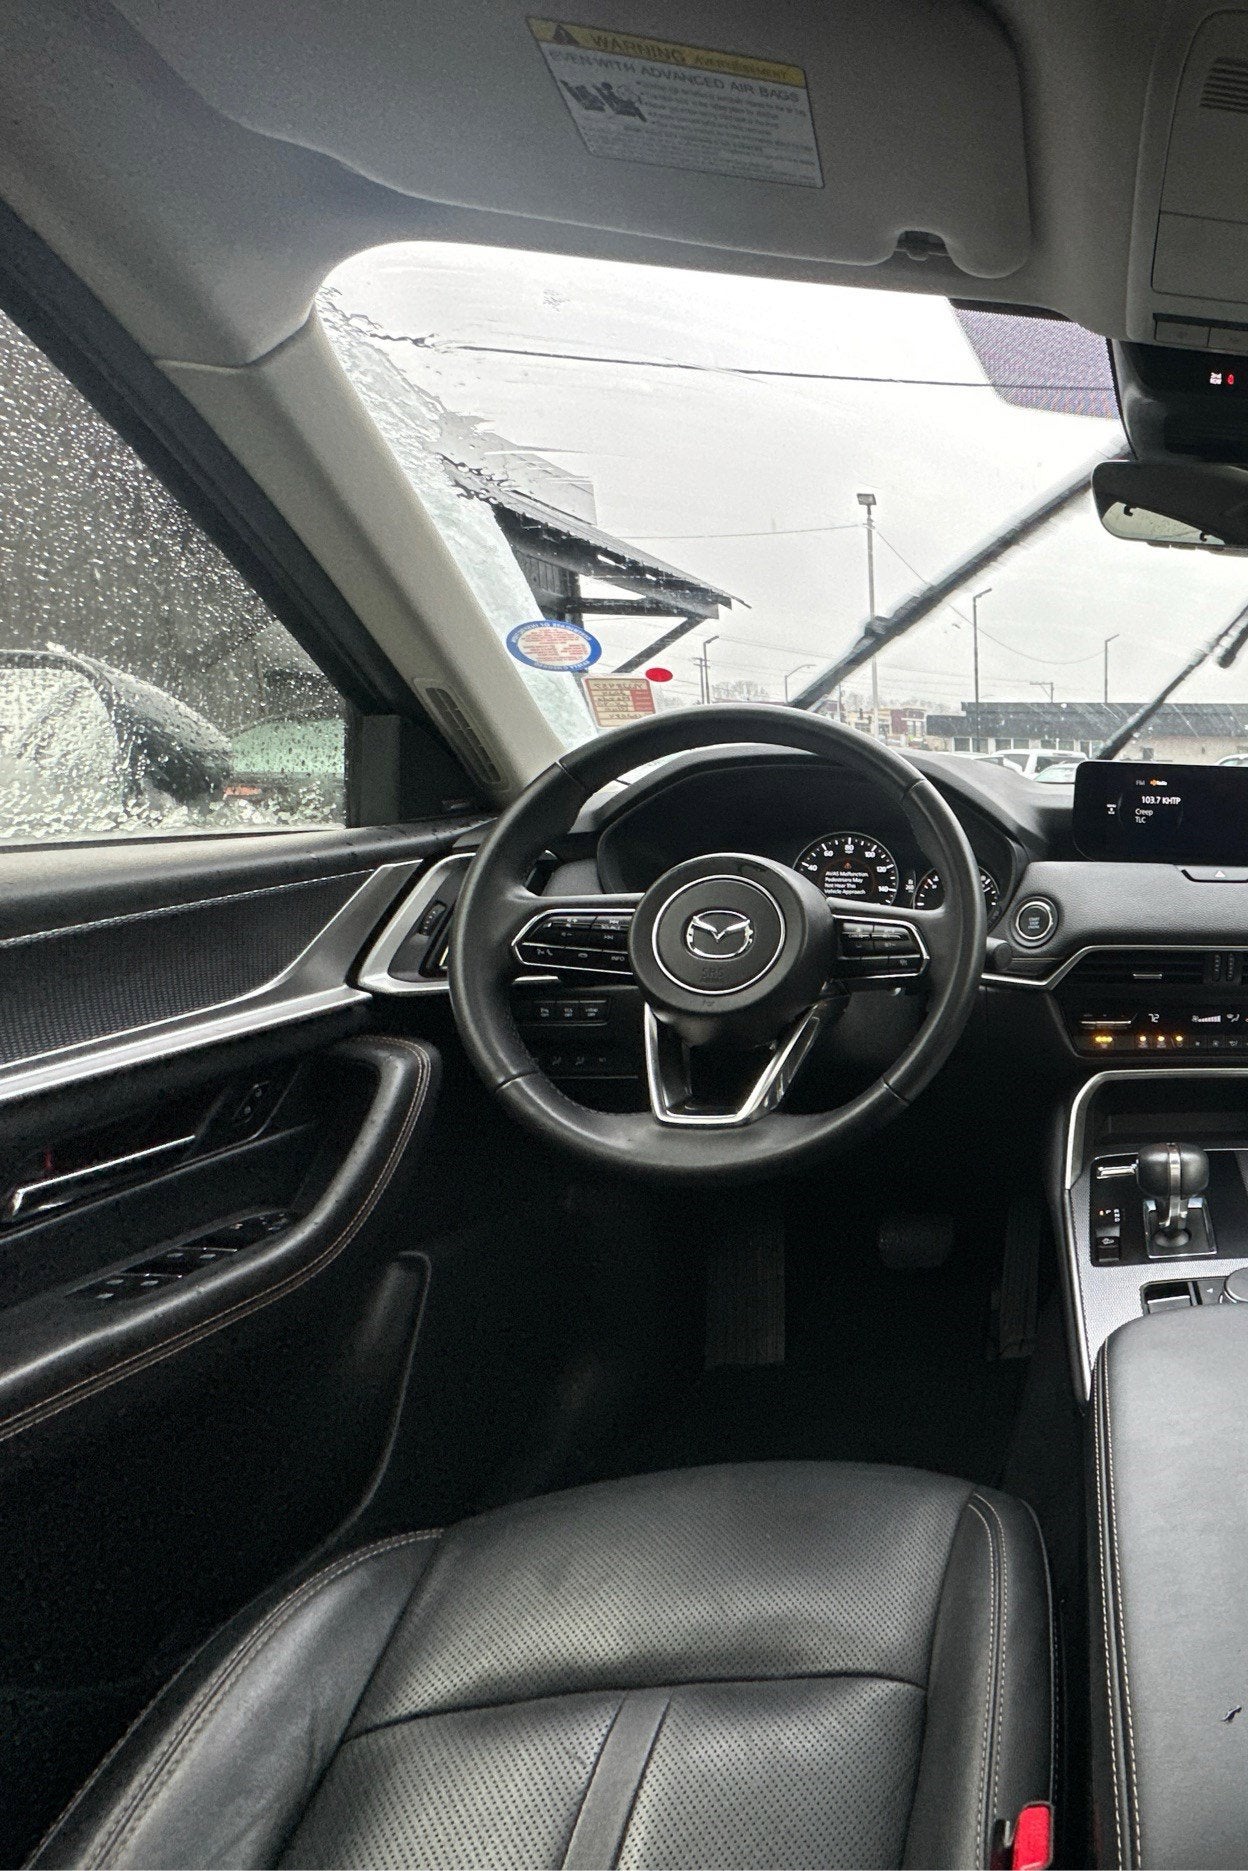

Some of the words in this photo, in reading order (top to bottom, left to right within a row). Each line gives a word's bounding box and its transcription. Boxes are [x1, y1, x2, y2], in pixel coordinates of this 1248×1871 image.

[592, 35, 686, 63] WARNING
[549, 49, 593, 65] EVEN
[597, 57, 636, 73] WITH
[641, 65, 725, 89] ADVANCED
[730, 81, 755, 95] AIR
[759, 86, 800, 103] BAGS
[1141, 795, 1161, 804] 103.7
[1162, 796, 1182, 805] KHTP
[1135, 808, 1154, 817] Creep
[1135, 816, 1146, 824] TLC
[1149, 1013, 1160, 1023] 72
